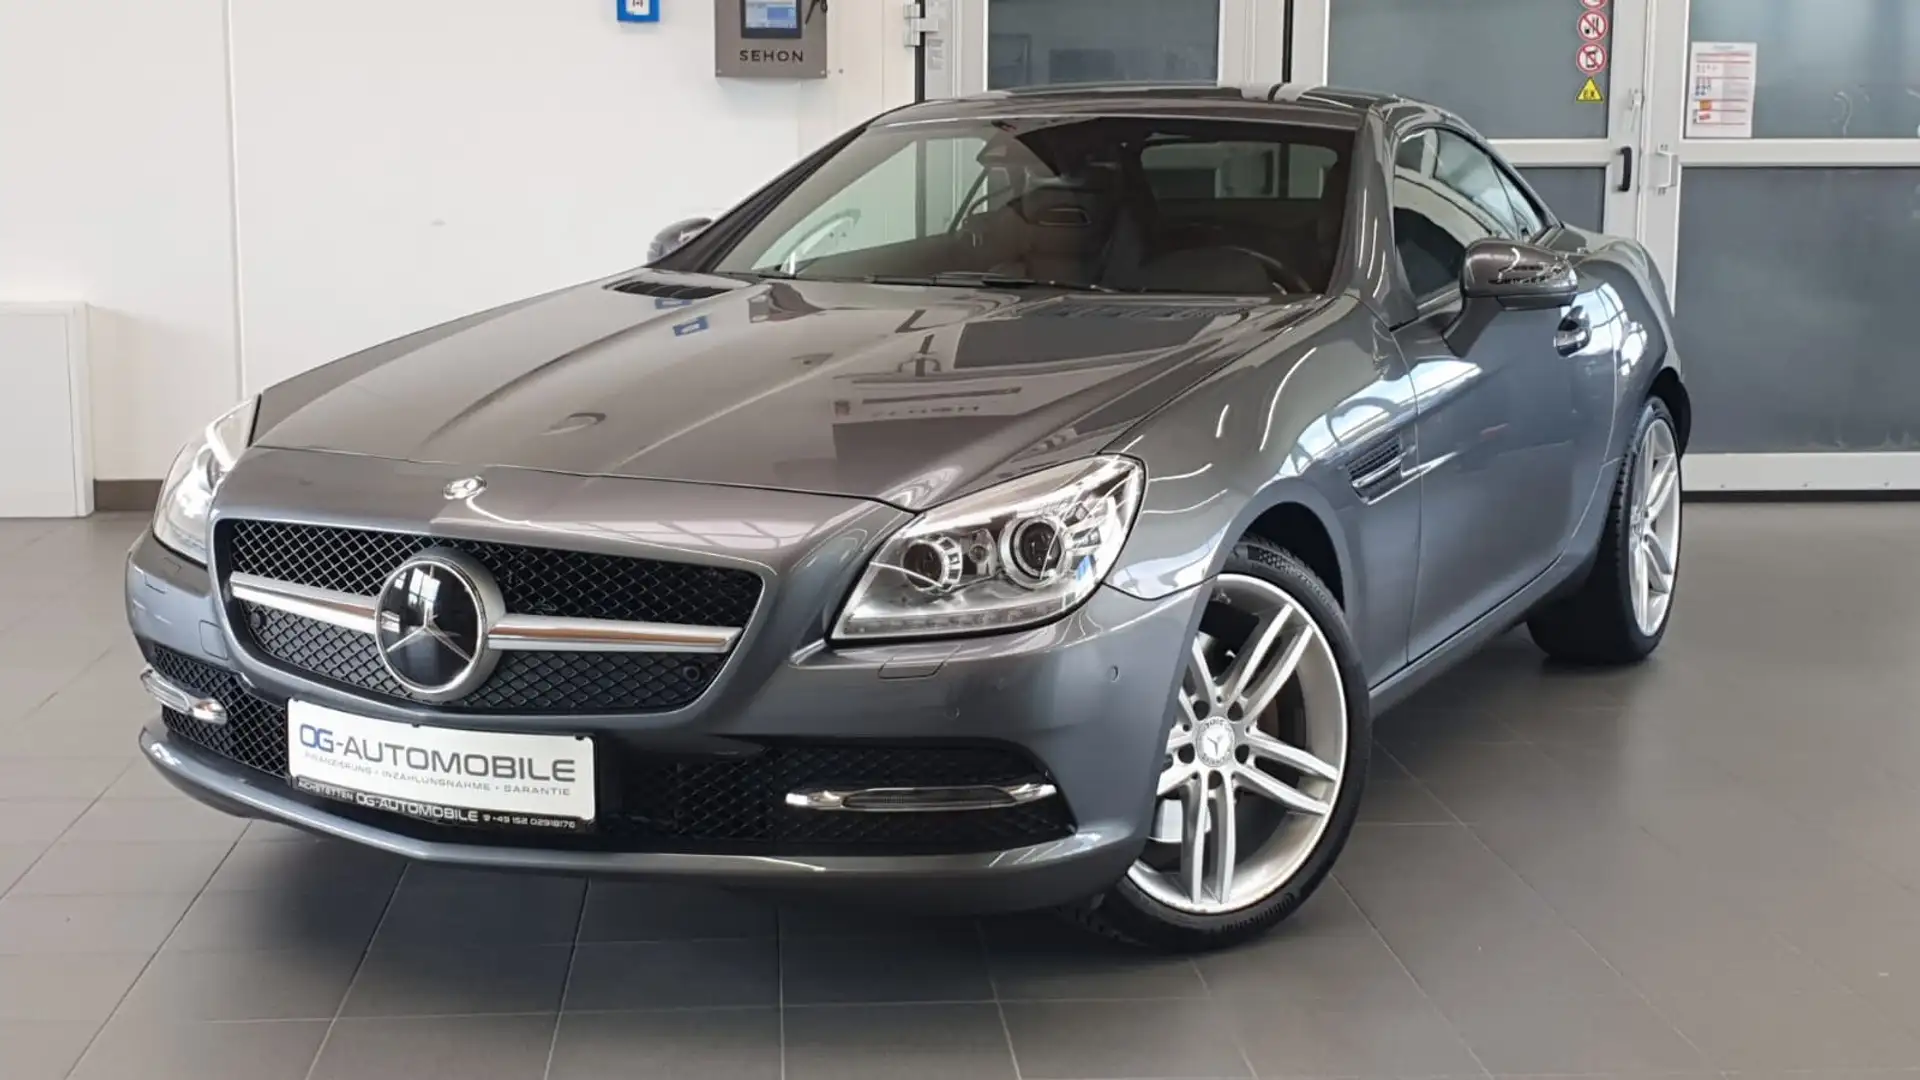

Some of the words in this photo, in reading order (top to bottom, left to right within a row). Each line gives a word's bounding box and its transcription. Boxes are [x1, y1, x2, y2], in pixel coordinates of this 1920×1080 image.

[740, 50, 804, 62] SEHON
[299, 723, 575, 782] OG-AUTOMOBILE
[503, 784, 571, 796] GARANTIE
[356, 792, 479, 822] OG-AUTOMOBILE
